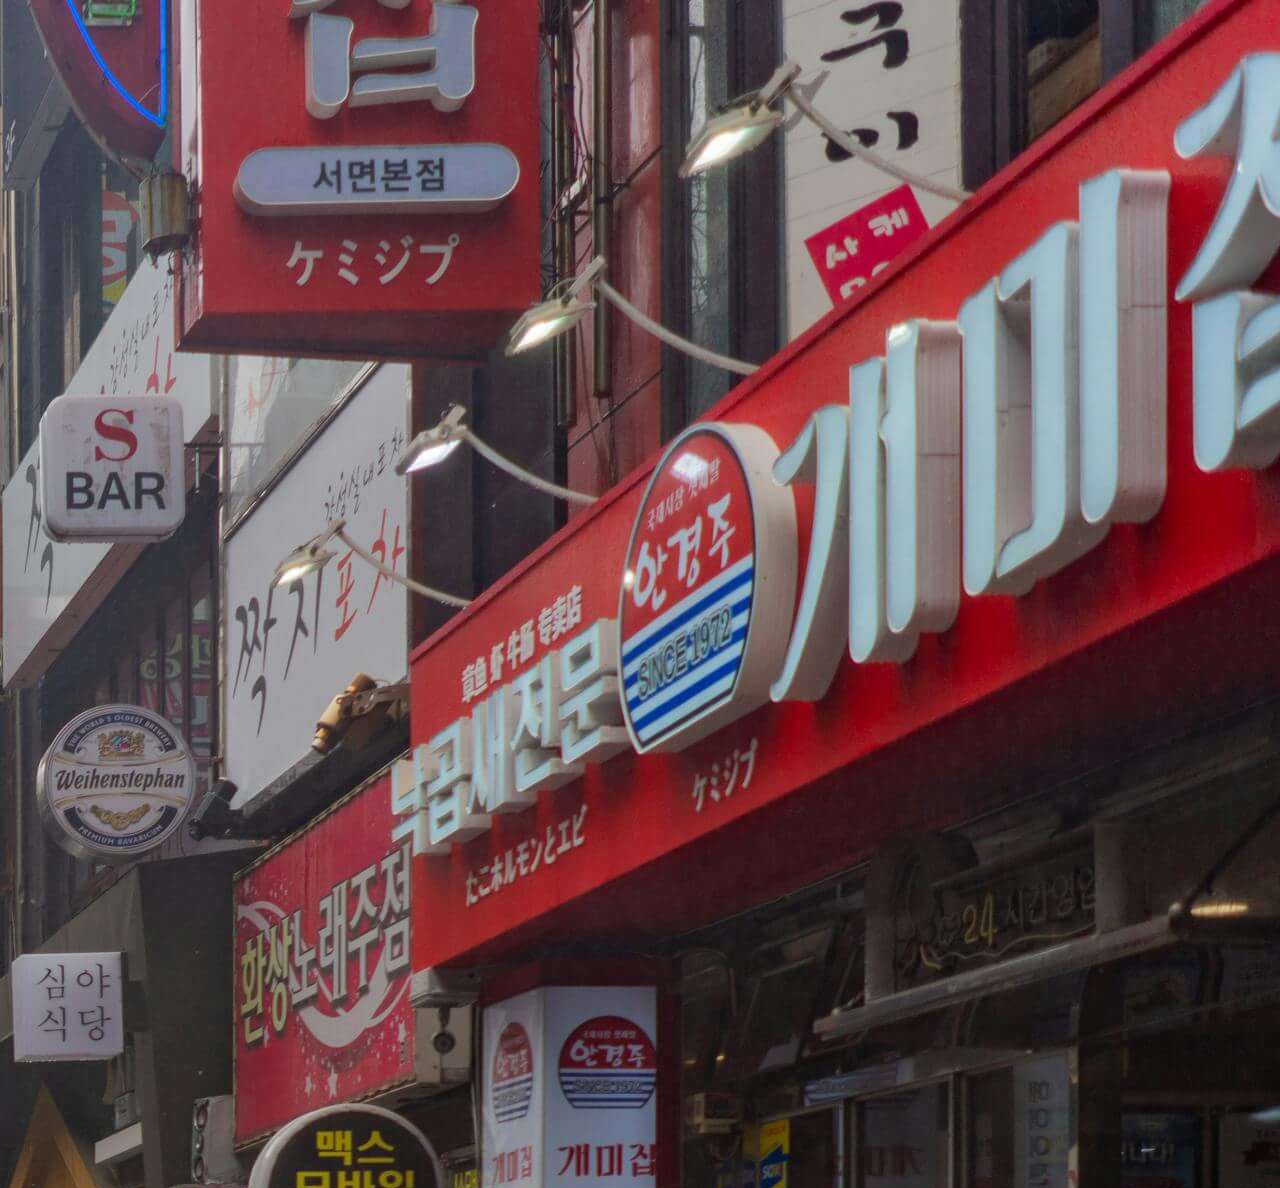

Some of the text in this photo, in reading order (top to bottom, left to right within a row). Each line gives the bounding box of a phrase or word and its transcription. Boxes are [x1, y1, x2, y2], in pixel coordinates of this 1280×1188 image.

[313, 158, 446, 194] 서면본점
[286, 232, 461, 287] ケミジプ
[94, 408, 139, 462] S
[64, 471, 167, 511] BAR
[334, 507, 406, 642] 포차
[637, 610, 734, 700] SINCE 1972
[55, 767, 186, 792] Weihenstephan
[288, 840, 412, 1006] 노래주점
[36, 963, 111, 1000] 심야
[240, 912, 293, 1044] 환상
[37, 1005, 112, 1040] 식당
[315, 1130, 396, 1166] 맥스
[491, 1143, 533, 1185] 개미집
[557, 1142, 657, 1178] 개미집
